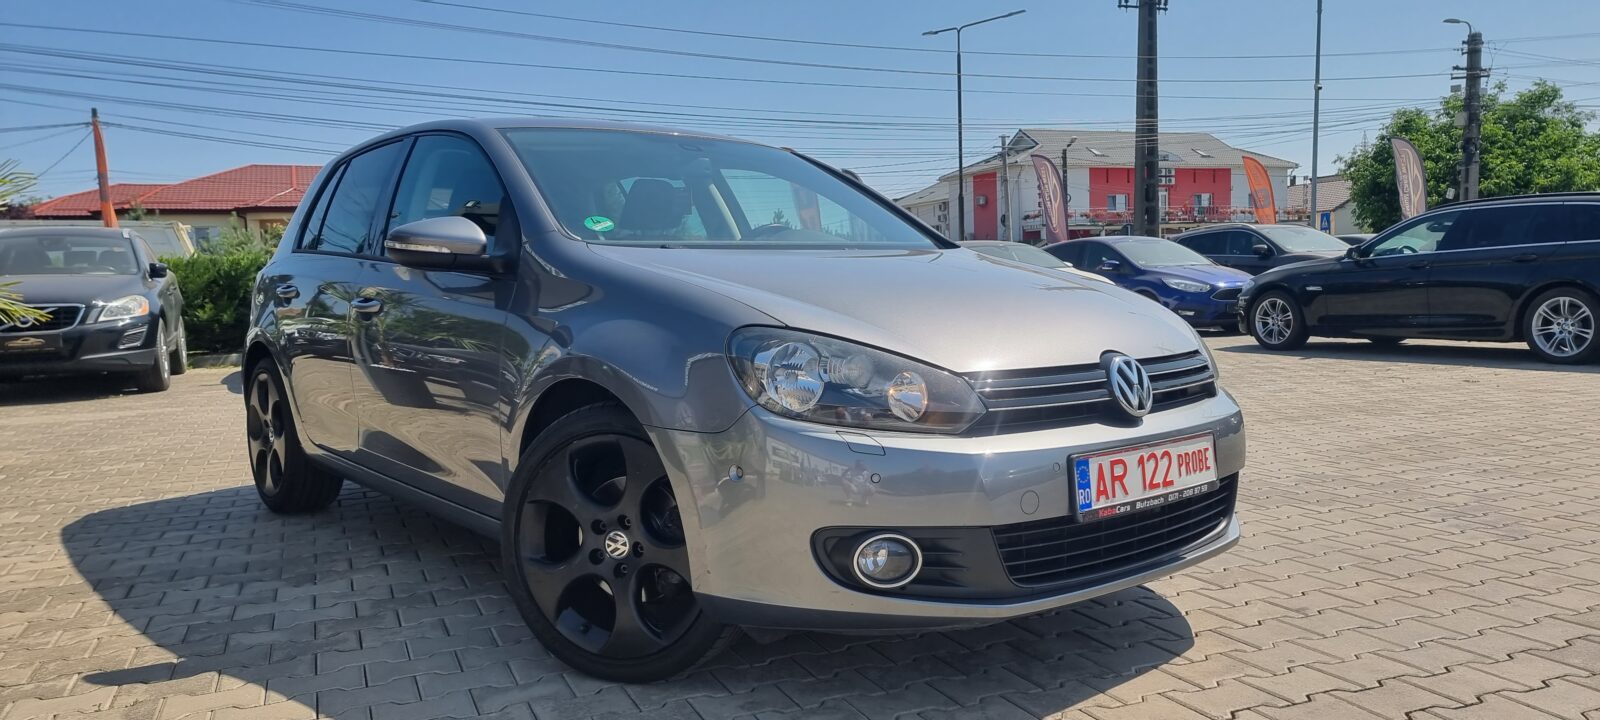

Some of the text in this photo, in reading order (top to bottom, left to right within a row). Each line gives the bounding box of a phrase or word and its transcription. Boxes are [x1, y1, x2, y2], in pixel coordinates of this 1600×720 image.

[1110, 356, 1153, 417] VW
[1079, 488, 1091, 506] RO
[1096, 447, 1211, 502] AR 122 PROBE
